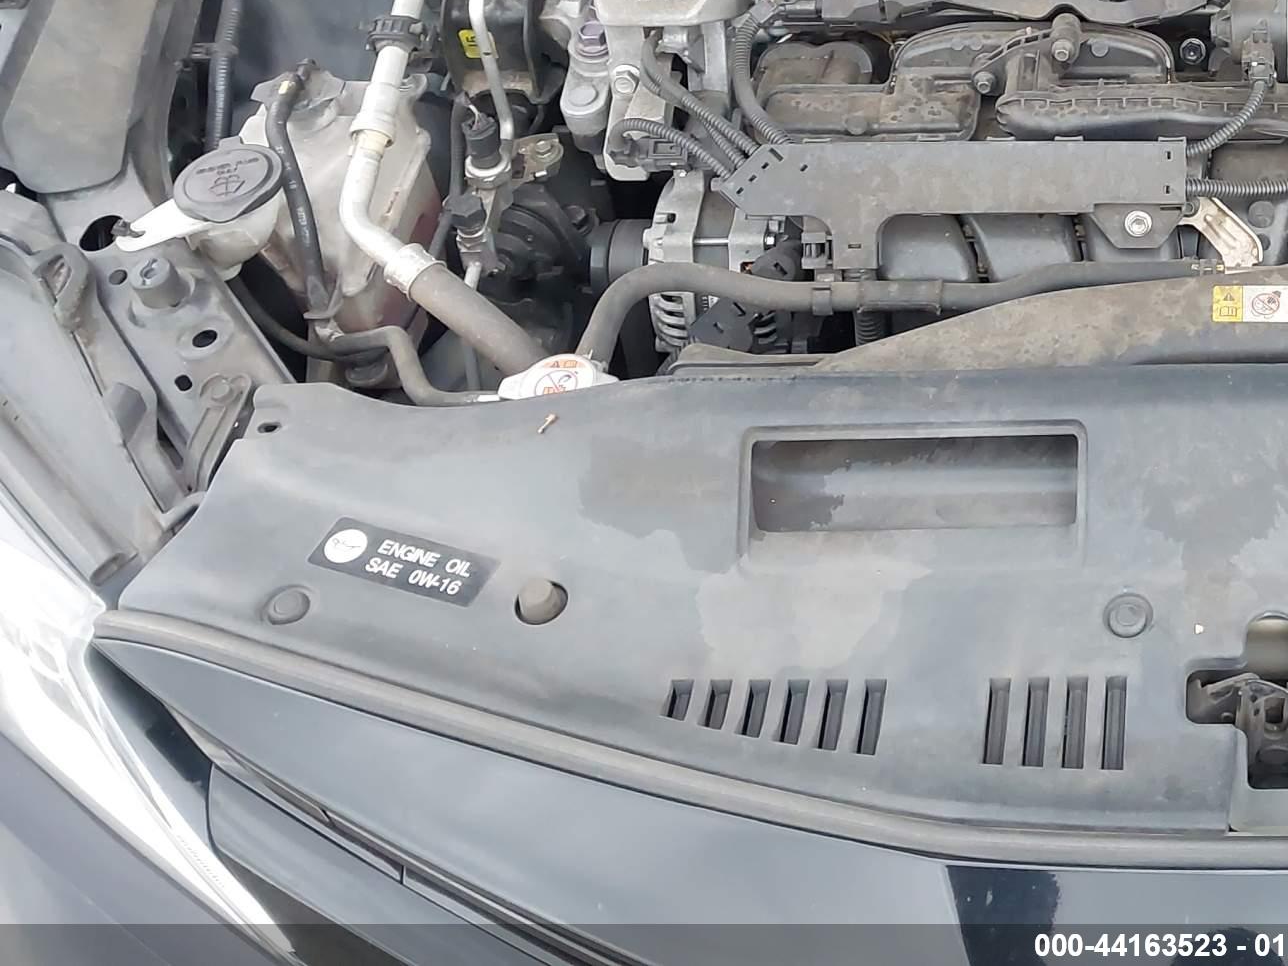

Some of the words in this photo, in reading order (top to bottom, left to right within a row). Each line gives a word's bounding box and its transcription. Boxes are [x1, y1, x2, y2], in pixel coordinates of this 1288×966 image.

[365, 558, 403, 578] SAE
[408, 570, 462, 595] 0W-16
[377, 539, 440, 567] ENGINE
[445, 559, 472, 578] OIL
